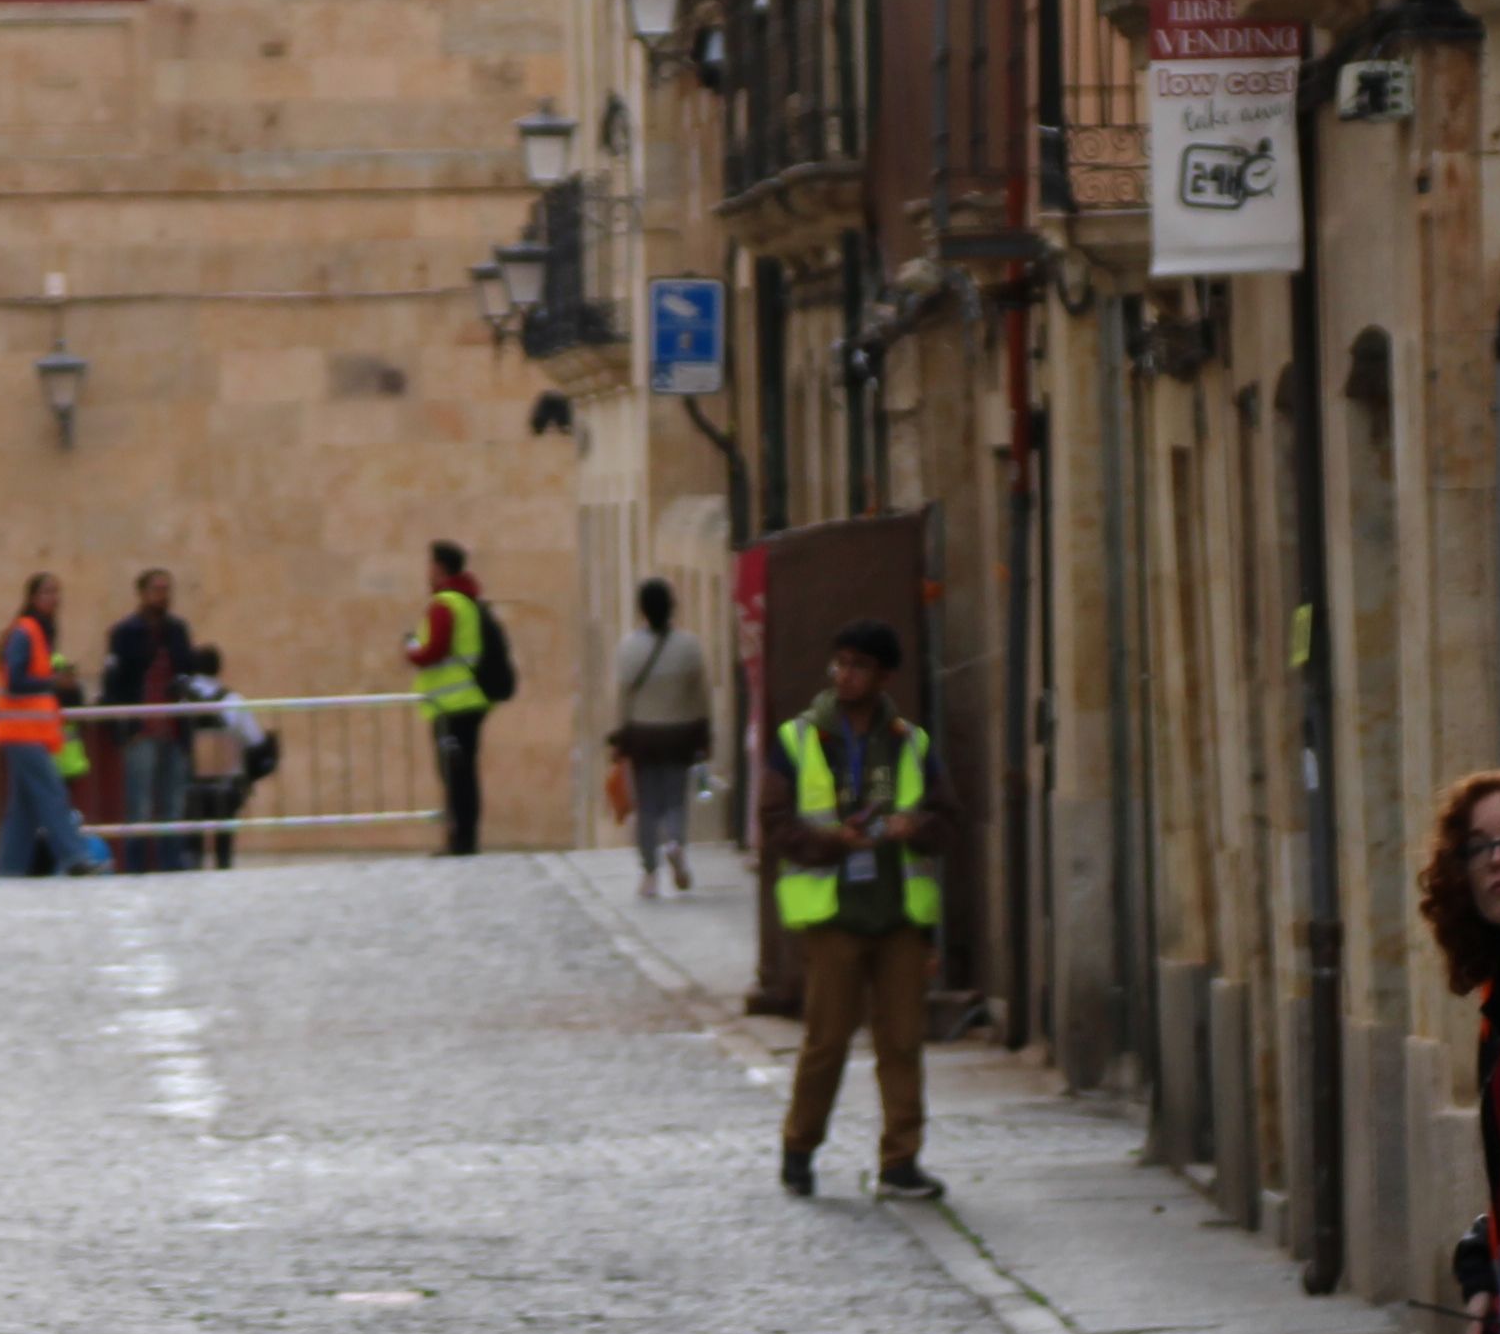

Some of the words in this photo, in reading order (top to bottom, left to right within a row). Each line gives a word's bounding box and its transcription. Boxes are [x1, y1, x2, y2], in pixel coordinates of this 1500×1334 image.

[1156, 27, 1299, 54] VENDING
[1157, 68, 1219, 97] low
[1224, 65, 1297, 96] cost
